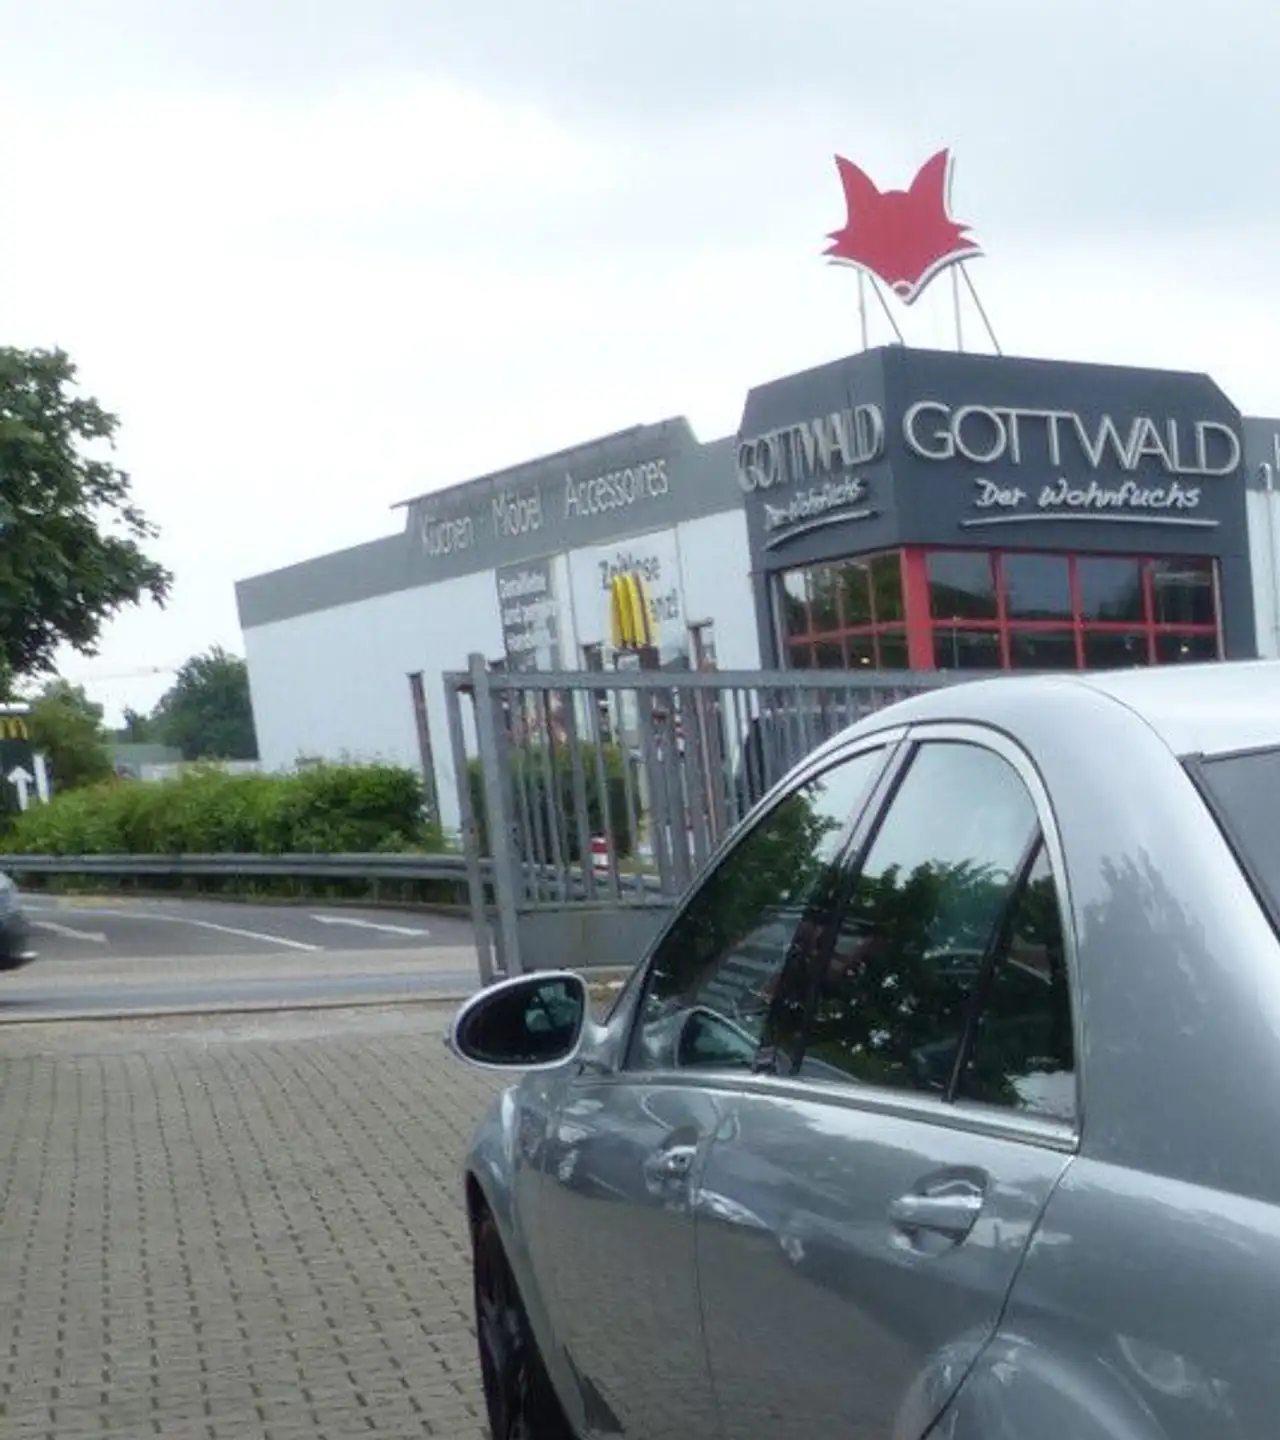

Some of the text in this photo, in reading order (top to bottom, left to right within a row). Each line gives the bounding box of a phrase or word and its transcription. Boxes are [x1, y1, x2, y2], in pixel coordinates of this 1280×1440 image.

[737, 403, 884, 492] GOTTWALD
[903, 401, 1240, 475] GOTTWALD
[492, 484, 543, 538] Möbel
[564, 460, 669, 520] Accessoires
[974, 476, 1201, 508] Der Wohnfuchs
